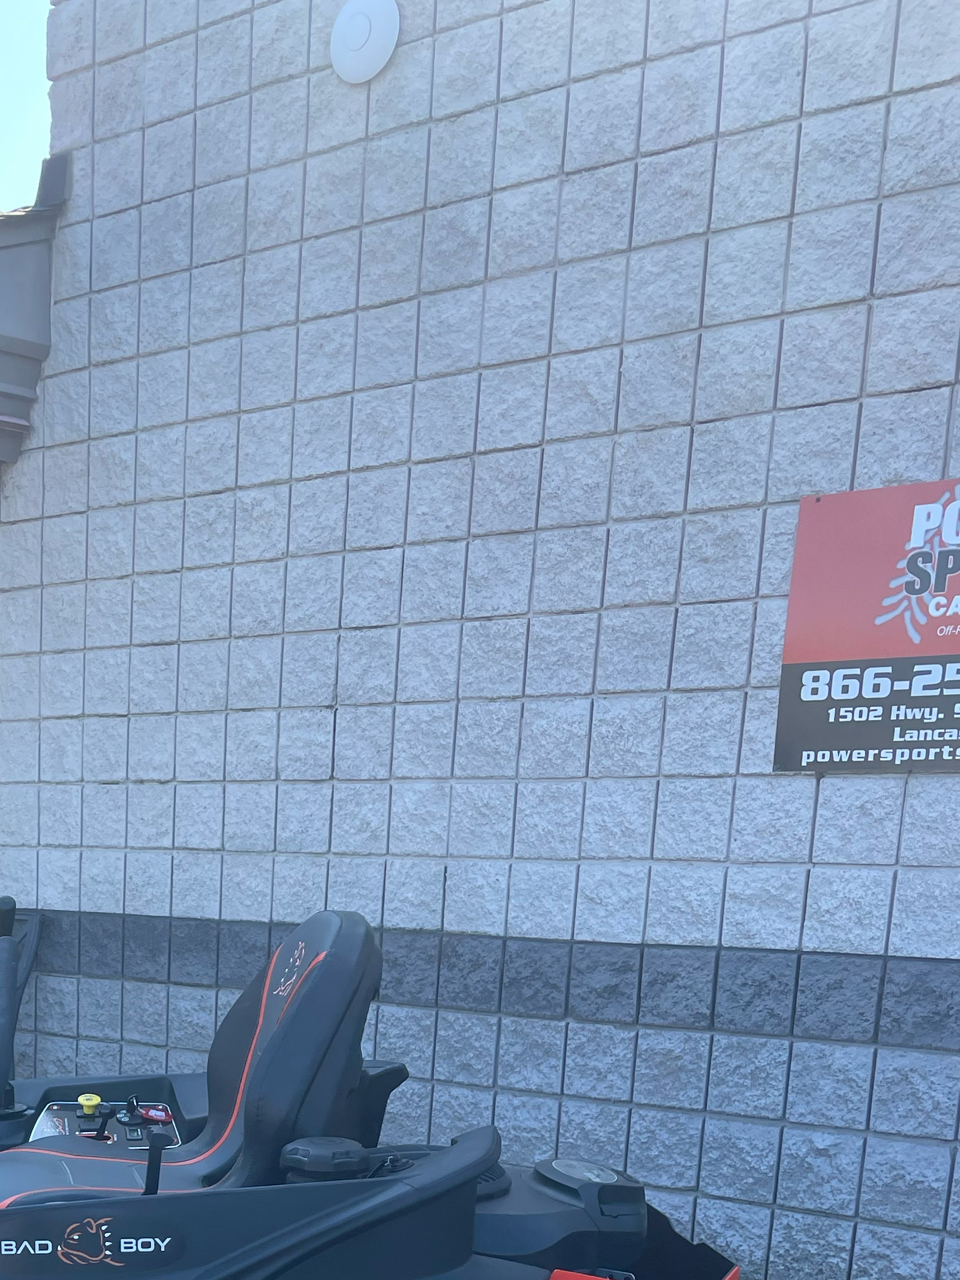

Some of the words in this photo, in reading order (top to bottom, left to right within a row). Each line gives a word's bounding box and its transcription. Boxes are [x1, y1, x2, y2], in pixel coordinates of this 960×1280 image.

[903, 549, 960, 597] SP
[928, 595, 960, 617] CA
[827, 706, 883, 723] 1502
[890, 705, 945, 722] Hwy.
[893, 726, 960, 742] Lanca
[1, 1240, 52, 1255] BAD
[120, 1237, 172, 1252] BOY
